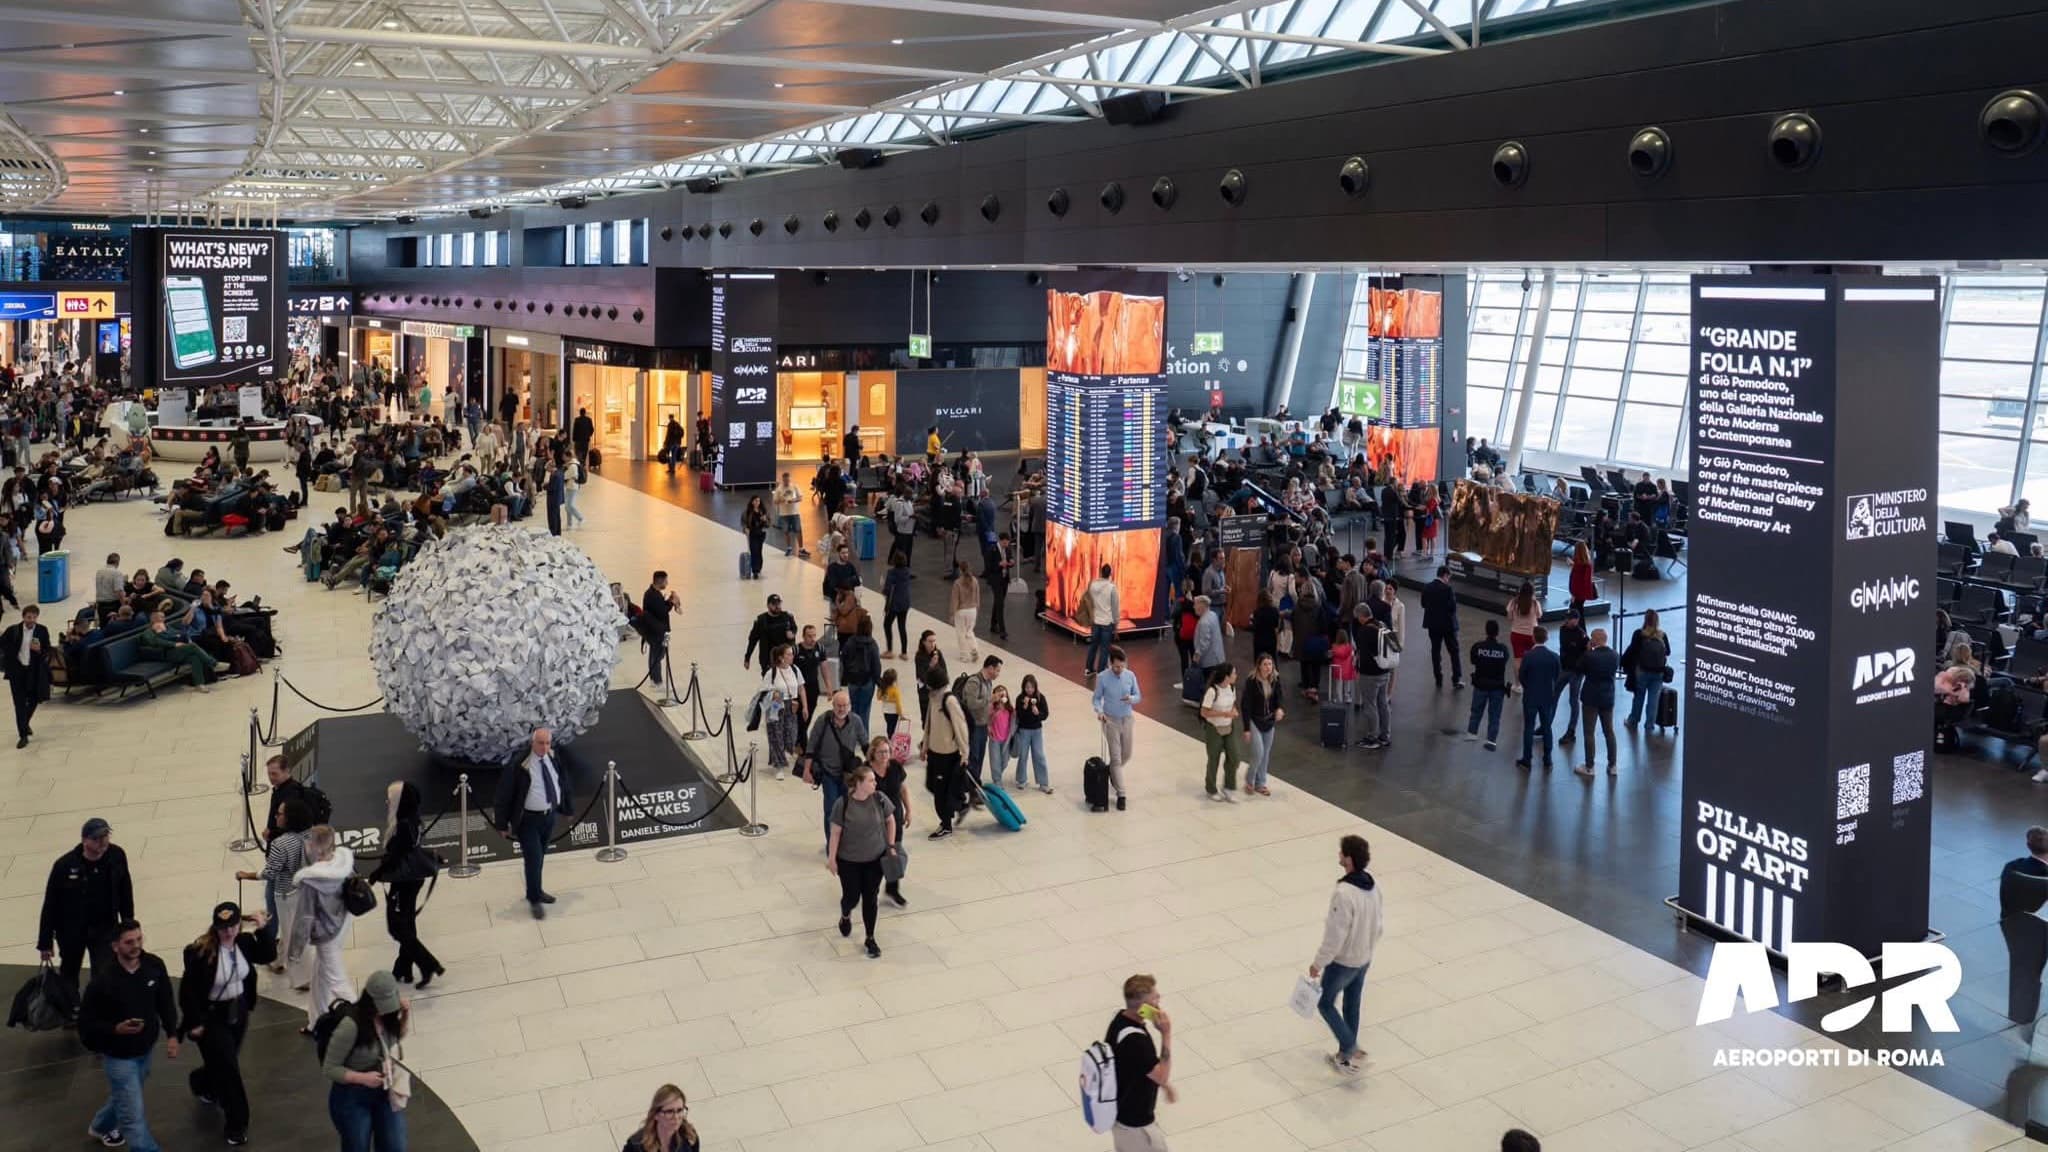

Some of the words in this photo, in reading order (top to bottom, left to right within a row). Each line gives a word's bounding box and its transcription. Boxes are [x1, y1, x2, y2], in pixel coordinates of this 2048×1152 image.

[56, 246, 125, 257] EATALY
[170, 241, 226, 255] WHAT'S
[229, 243, 268, 255] NEW?
[170, 255, 251, 269] WHATSAPP!
[1700, 352, 1763, 375] FOLLA
[736, 387, 767, 400] ADR
[1700, 374, 1710, 385] di
[1711, 375, 1730, 387] Giò
[1731, 376, 1789, 393] Pomodoro,
[1699, 389, 1719, 399] uno
[1721, 389, 1737, 401] dei
[1739, 392, 1795, 406] capolavori
[1699, 401, 1724, 413] della
[1726, 403, 1767, 417] Galleria
[1769, 407, 1824, 423] Nazionale
[1732, 417, 1779, 433] Moderna
[1699, 429, 1706, 437] e
[1707, 428, 1792, 448] Contemporanea
[1698, 454, 1712, 468] by
[1713, 456, 1731, 469] Giò
[1732, 459, 1790, 479] Pomodoro,
[1698, 470, 1718, 480] one
[1719, 472, 1731, 482] of
[1732, 473, 1750, 485] the
[1752, 478, 1823, 497] masterpieces
[1698, 482, 1711, 493] of
[1711, 483, 1728, 495] the
[1730, 486, 1774, 502] National
[1776, 493, 1815, 511] Gallery
[1698, 496, 1711, 506] of
[1711, 497, 1750, 513] Modern
[1752, 505, 1773, 517] and
[1875, 488, 1927, 506] MINISTERO
[1698, 508, 1771, 532] Contemporary
[1772, 520, 1791, 534] Art
[1875, 506, 1900, 520] DELLA
[1875, 516, 1926, 536] CULTURA
[1696, 605, 1716, 616] sono
[1717, 610, 1762, 628] conservate
[1763, 620, 1784, 633] oltre
[1785, 625, 1815, 641] 20.000
[1738, 603, 1759, 616] della
[1760, 608, 1797, 625] GNAMC
[1696, 616, 1719, 629] opere
[1720, 620, 1732, 631] tra
[1763, 631, 1798, 649] disegni,
[1696, 626, 1728, 641] sculture
[1728, 634, 1735, 643] e
[1736, 635, 1788, 656] installazioni.
[1695, 658, 1711, 670] The
[1712, 663, 1748, 680] GNAMC
[1748, 673, 1773, 688] hosts
[1775, 681, 1795, 694] over
[1852, 648, 1915, 690] ADR
[1694, 680, 1735, 699] paintings,
[1737, 691, 1778, 712] drawings,
[1695, 669, 1726, 685] 20,000
[1727, 679, 1753, 693] works
[1755, 686, 1796, 707] including
[1695, 690, 1738, 710] sculptures
[616, 790, 674, 808] MASTER
[678, 787, 697, 800] OF
[618, 801, 691, 822] MISTAKES
[621, 825, 660, 839] DANIELE
[1698, 800, 1808, 862] PILLARS
[1696, 828, 1736, 863] OF
[1740, 847, 1808, 892] ART
